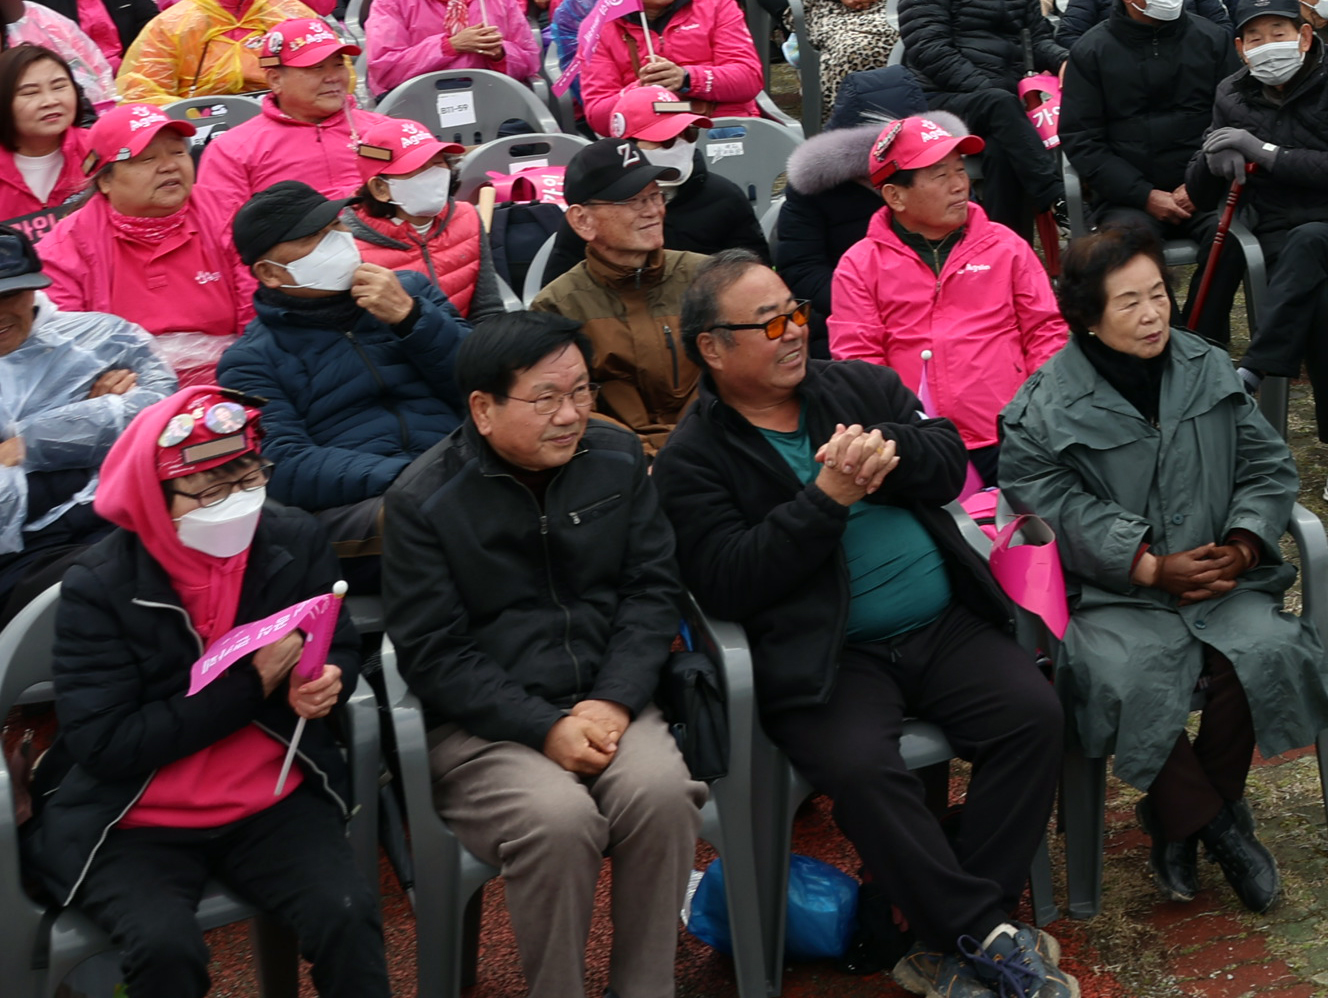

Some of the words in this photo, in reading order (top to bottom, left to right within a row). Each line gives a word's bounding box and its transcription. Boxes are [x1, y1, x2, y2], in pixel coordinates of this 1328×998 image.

[305, 31, 335, 45] Again
[130, 113, 169, 132] Again
[400, 130, 434, 149] Again
